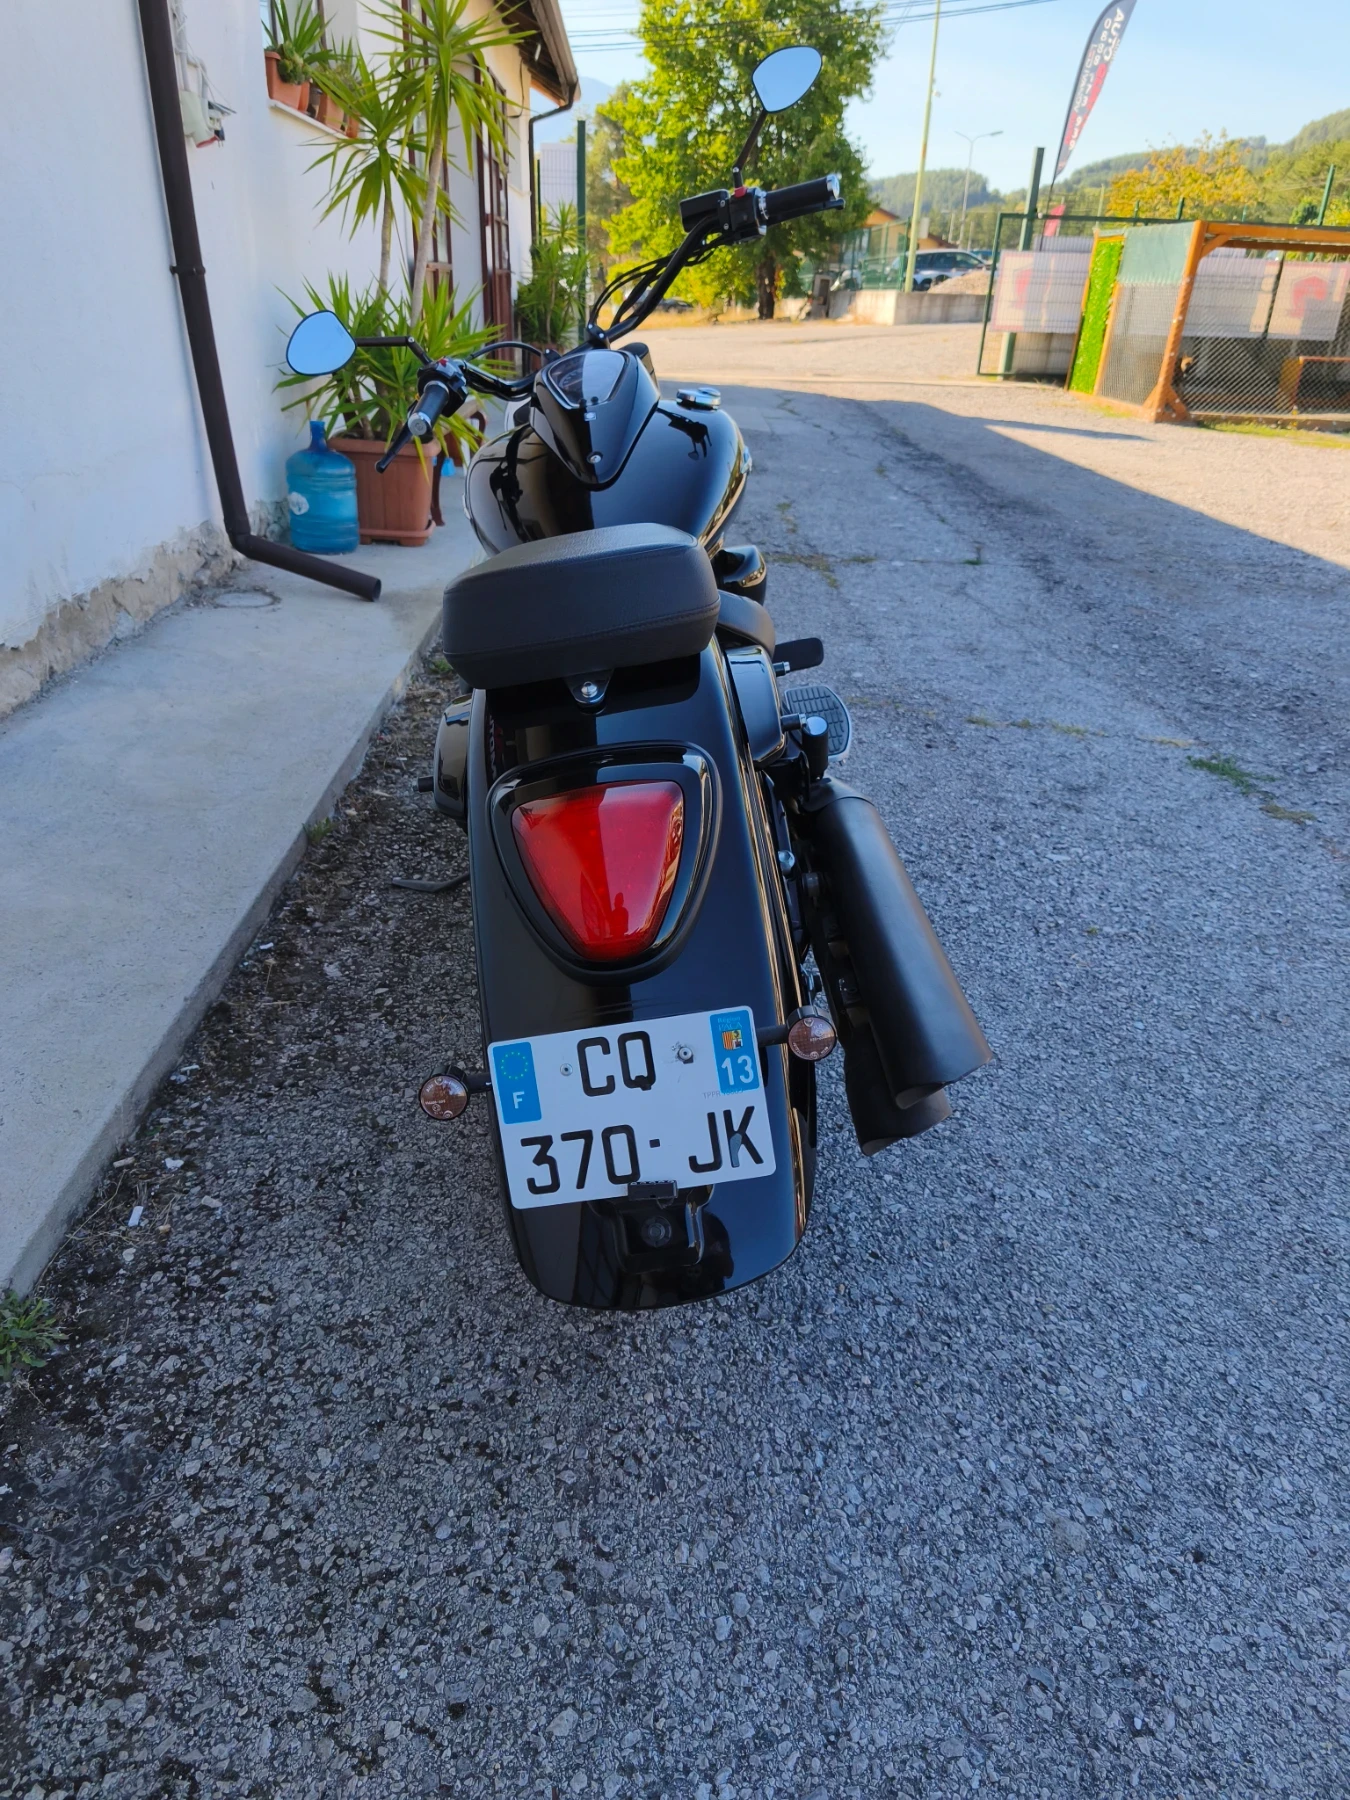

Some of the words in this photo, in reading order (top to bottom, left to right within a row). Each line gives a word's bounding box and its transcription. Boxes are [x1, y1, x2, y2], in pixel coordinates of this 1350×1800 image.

[1103, 7, 1125, 61] AUTO
[577, 1030, 656, 1097] CQ
[721, 1055, 754, 1086] 13
[512, 1091, 525, 1109] F
[688, 1105, 764, 1174] JK
